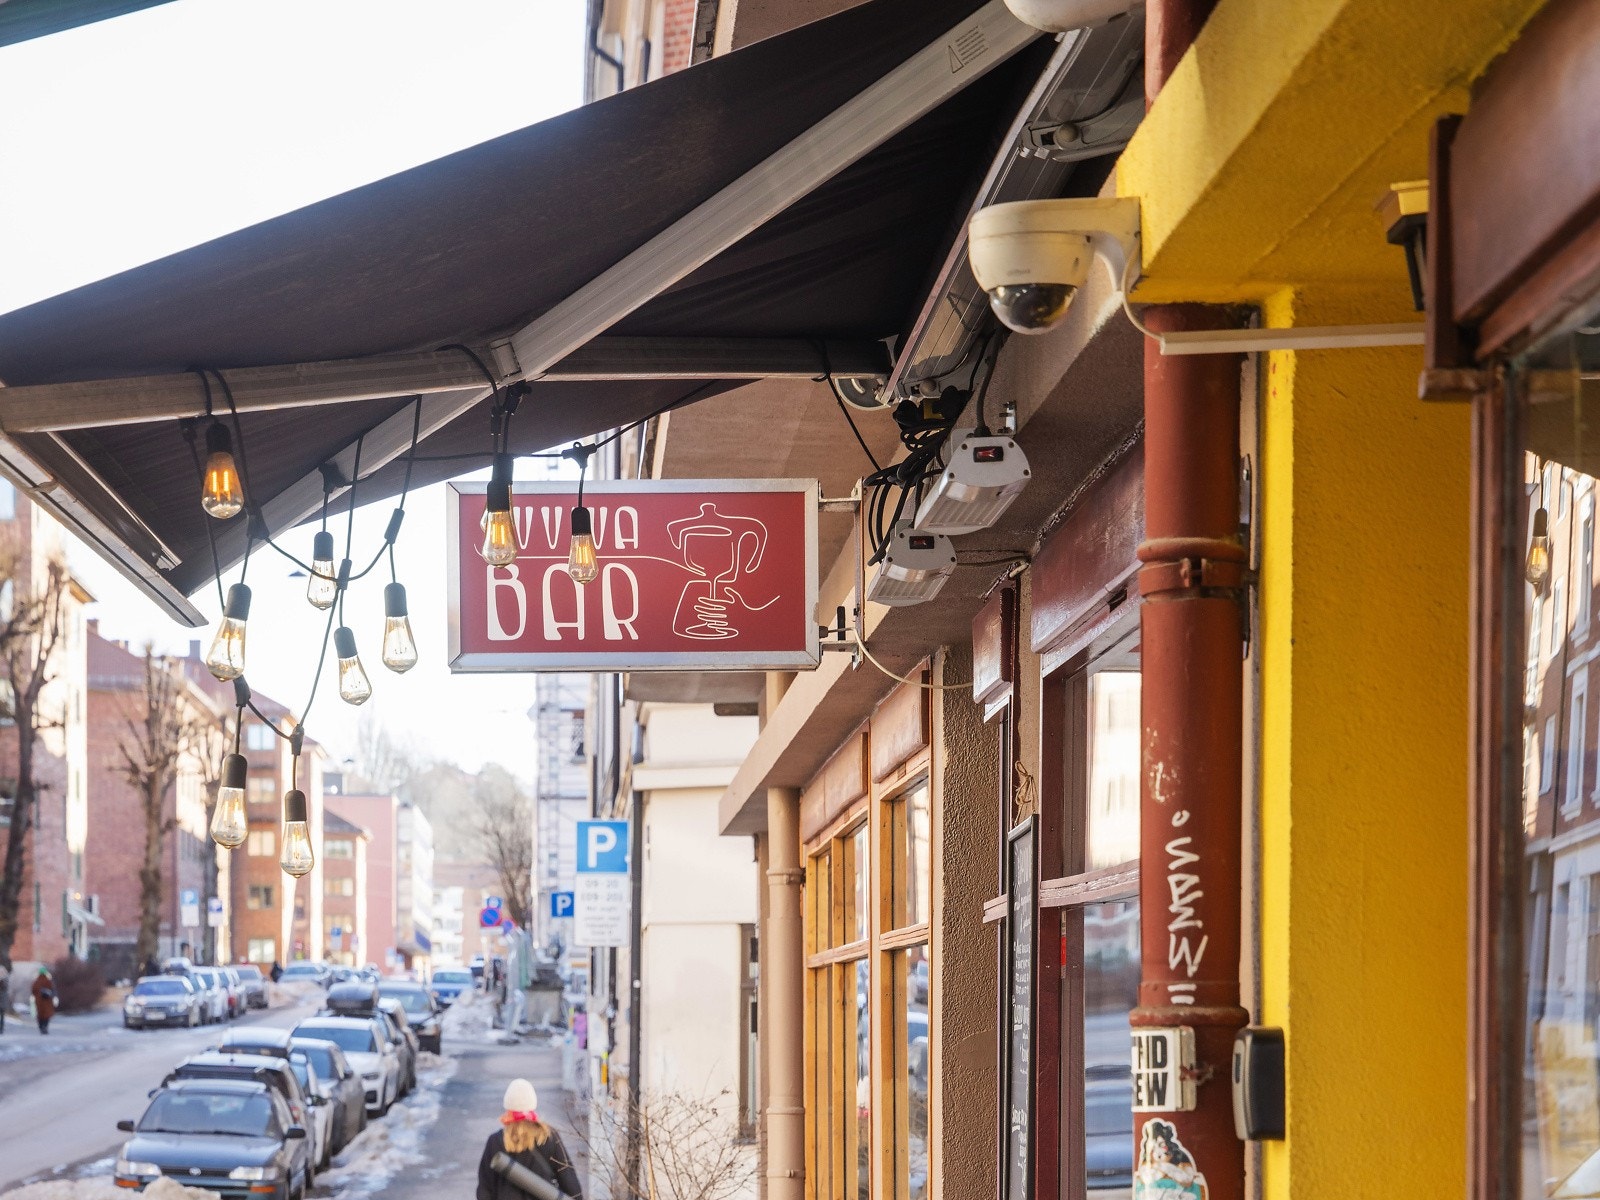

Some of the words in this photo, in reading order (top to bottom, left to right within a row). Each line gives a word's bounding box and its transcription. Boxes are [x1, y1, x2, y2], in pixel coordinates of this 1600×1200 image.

[487, 506, 639, 550] VVVA
[486, 562, 639, 641] BAR
[587, 825, 618, 868] P
[556, 894, 572, 917] P
